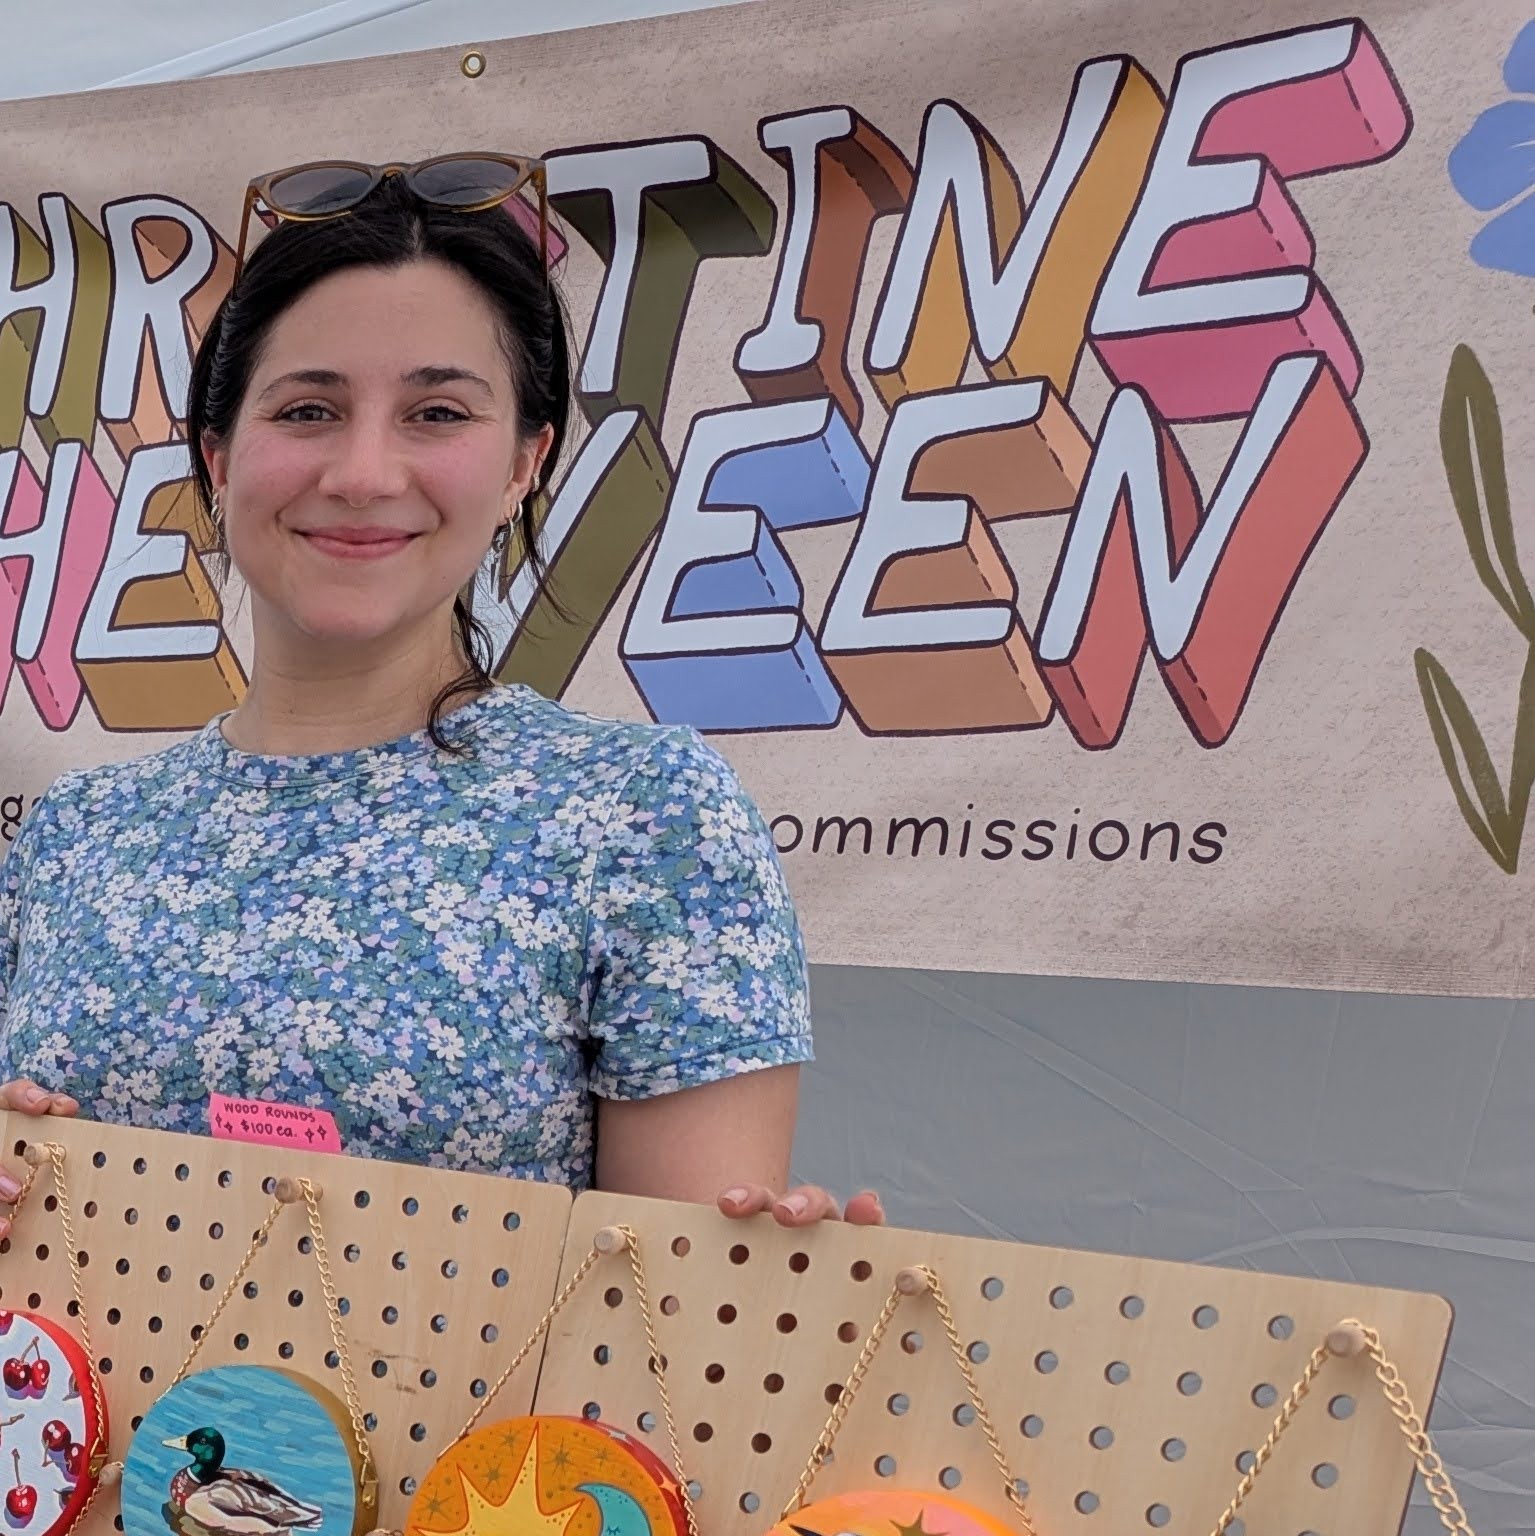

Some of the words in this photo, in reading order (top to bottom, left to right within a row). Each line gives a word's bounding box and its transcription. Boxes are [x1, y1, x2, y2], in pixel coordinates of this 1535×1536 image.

[768, 802, 1228, 866] ommissions
[224, 1102, 259, 1115] WOOD
[265, 1106, 316, 1123] ROUNDS
[240, 1119, 273, 1135] $100
[276, 1125, 298, 1138] ea.
